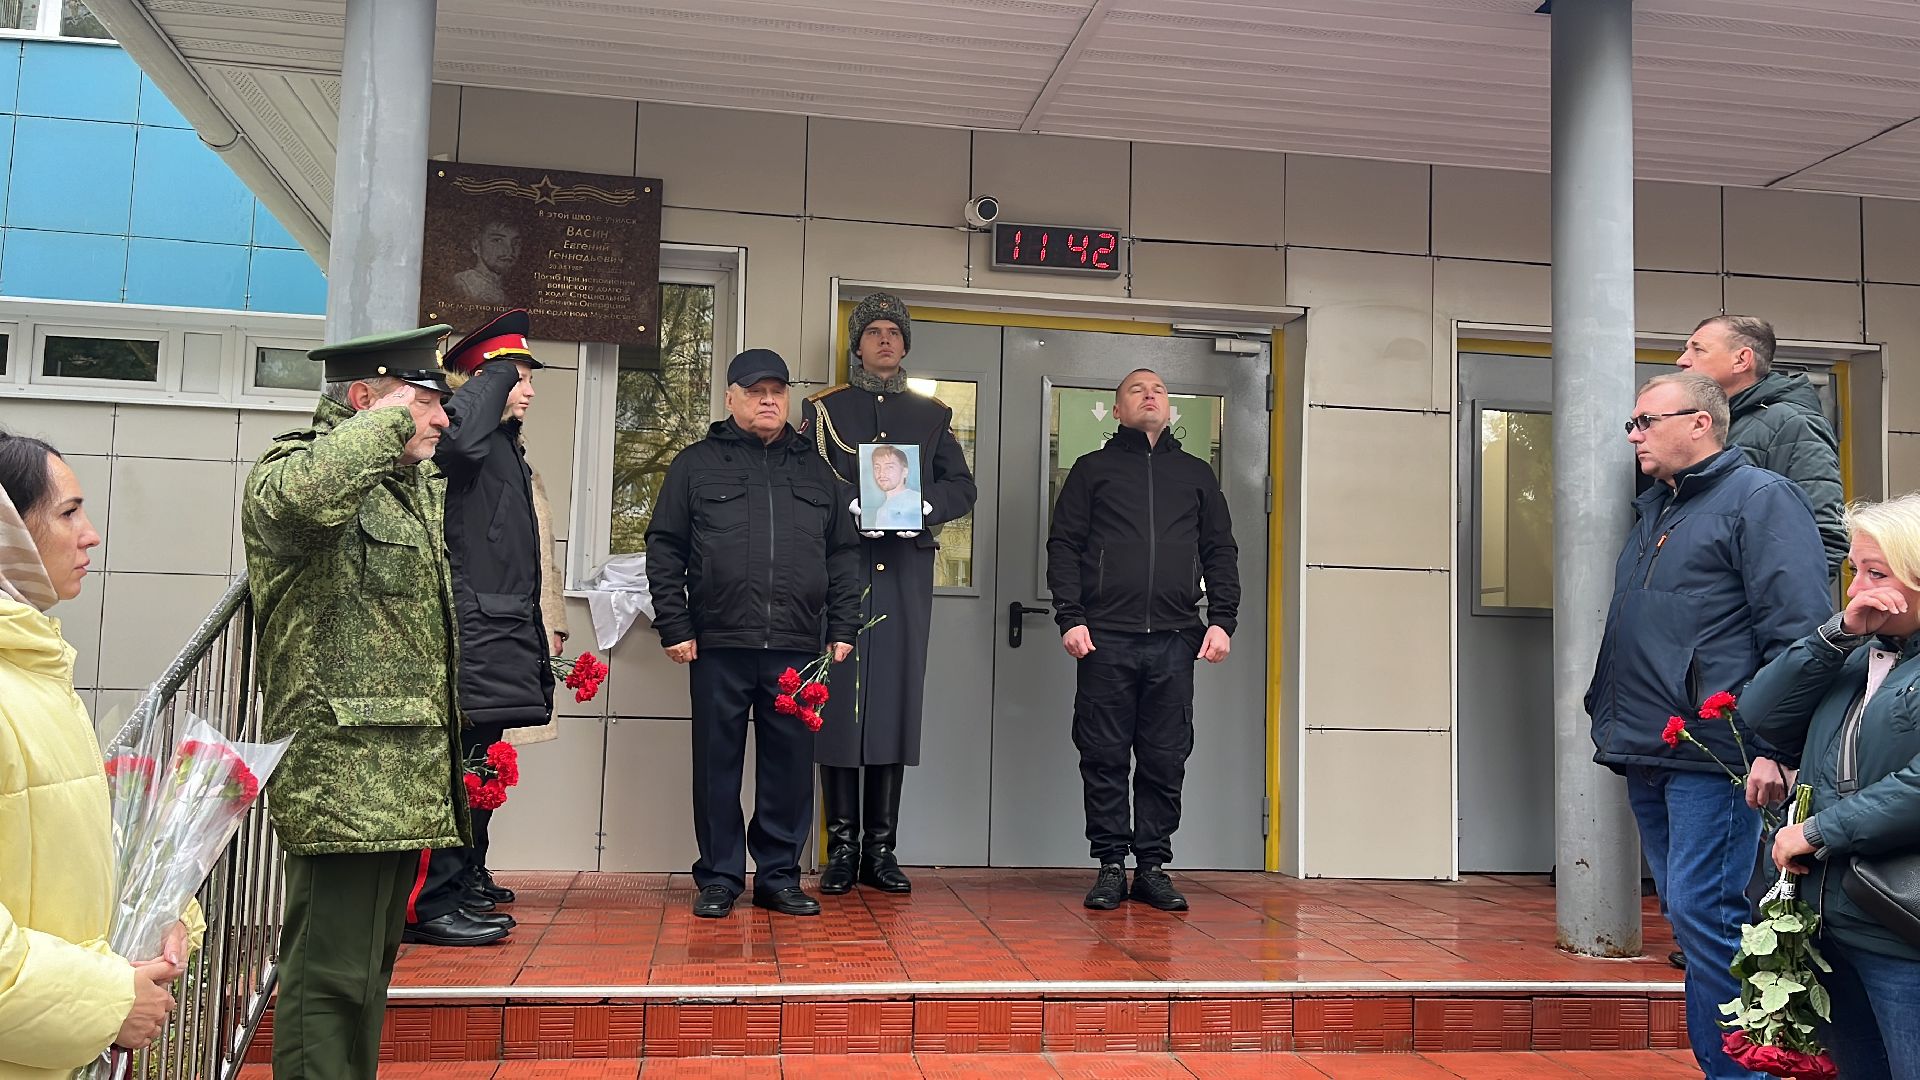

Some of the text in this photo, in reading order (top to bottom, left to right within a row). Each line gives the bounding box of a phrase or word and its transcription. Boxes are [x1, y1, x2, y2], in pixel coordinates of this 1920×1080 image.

[547, 212, 569, 220] этой
[572, 213, 602, 222] школе
[605, 216, 638, 225] учился
[566, 225, 609, 239] ВАСИН
[563, 239, 610, 252] Евгений
[1013, 230, 1116, 269] 11 42
[548, 249, 625, 264] Геннадьевич
[533, 271, 636, 287] Погиб при исполнении
[546, 282, 594, 292] воинского
[545, 289, 567, 298] ходе
[569, 291, 631, 303] Специальной
[579, 299, 626, 310] Операции
[546, 308, 589, 318] орденом
